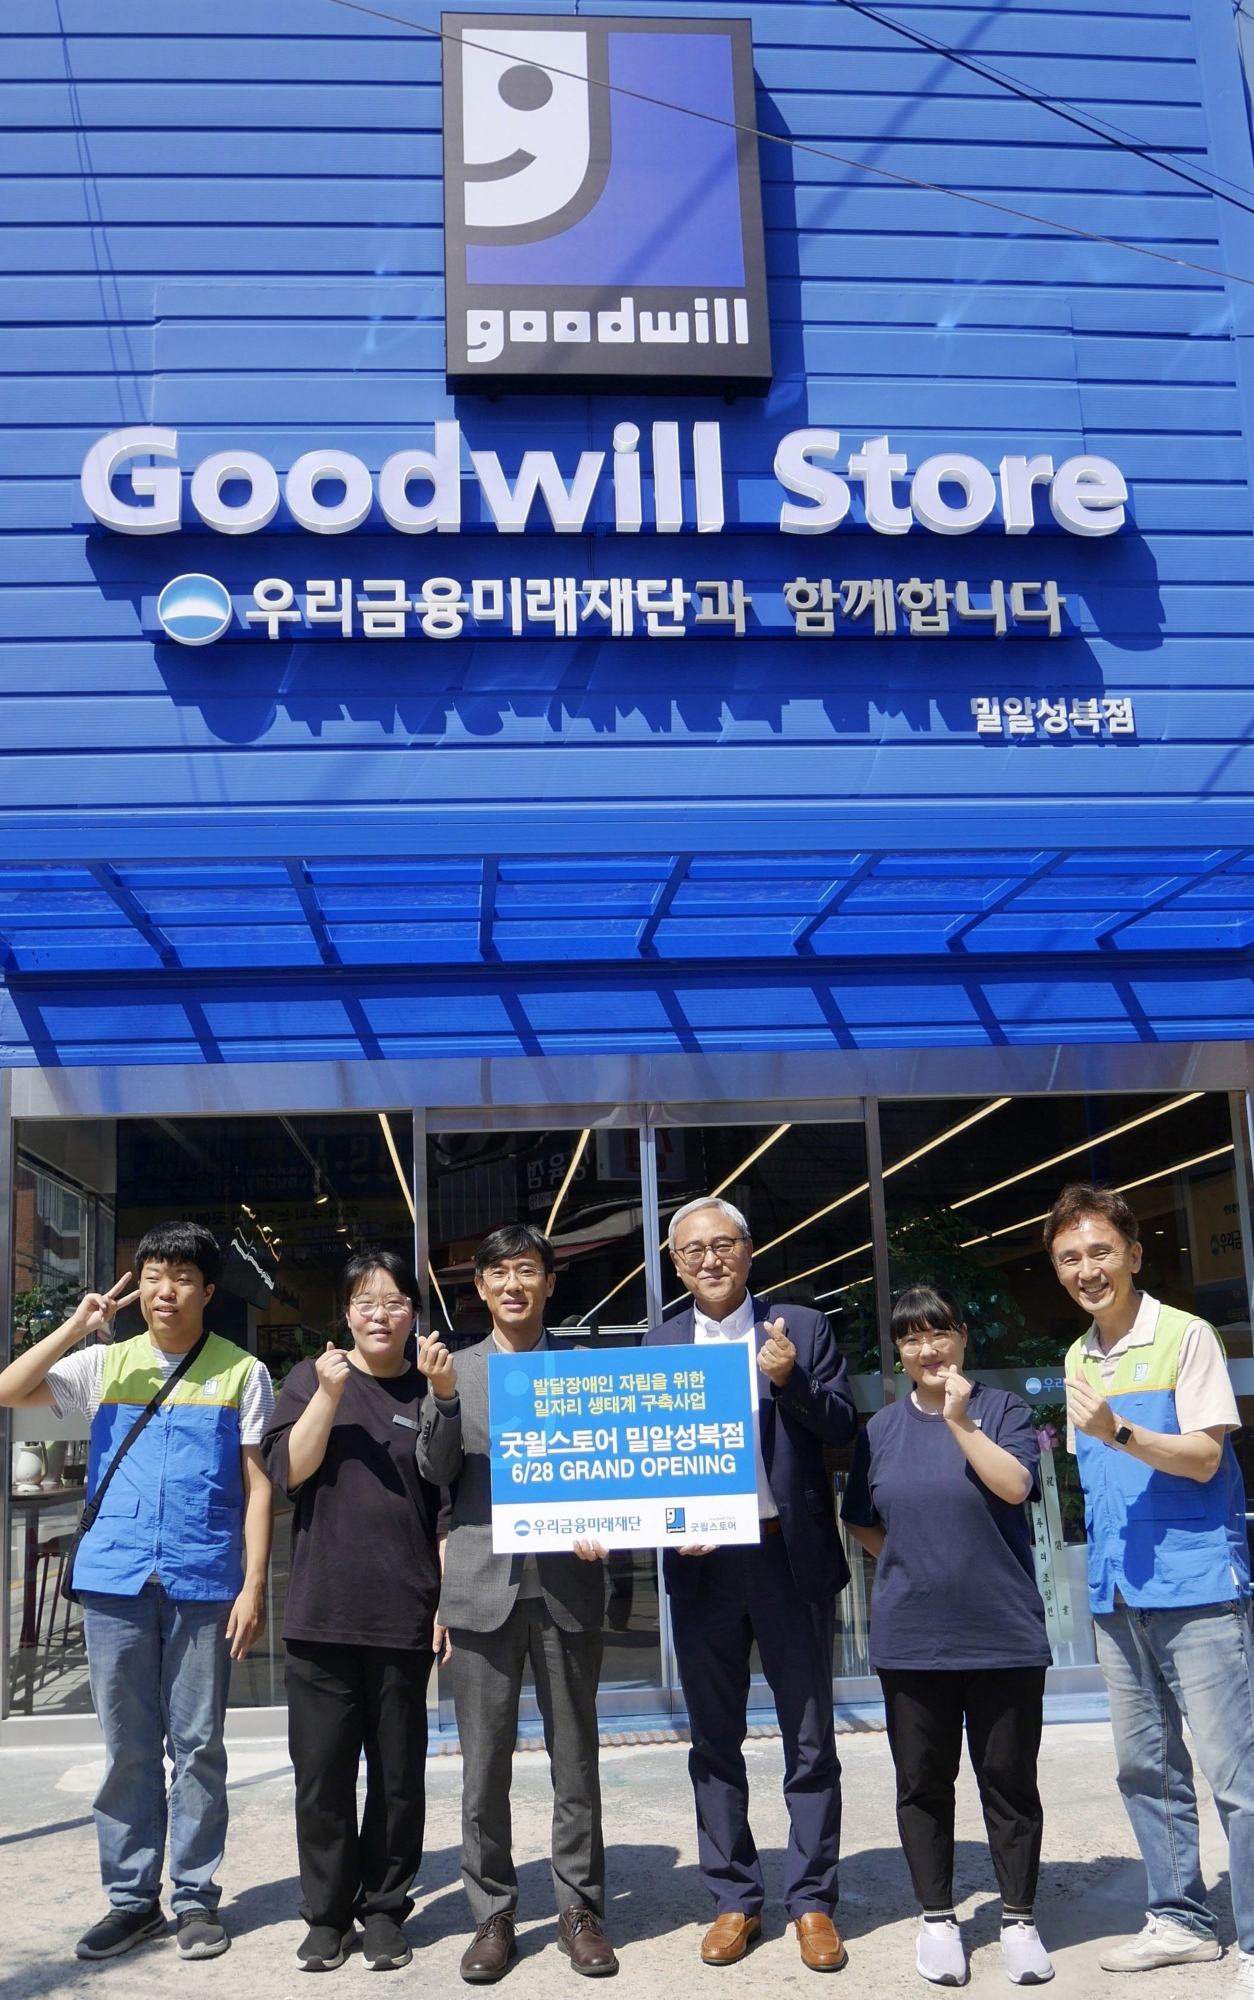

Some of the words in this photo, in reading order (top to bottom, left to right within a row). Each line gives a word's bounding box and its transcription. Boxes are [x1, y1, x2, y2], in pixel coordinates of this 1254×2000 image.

[466, 297, 749, 363] goodwill
[81, 420, 724, 536] Goodwill
[774, 428, 1129, 537] Store
[246, 577, 752, 640] 우리금융미래재단과
[784, 576, 1066, 637] 함께합니다
[971, 697, 1135, 735] 밀알성북점
[533, 1374, 614, 1396] 발달장애인
[619, 1372, 668, 1393] 자립을
[673, 1370, 705, 1389] 위한
[534, 1397, 582, 1417] 일자리
[588, 1395, 636, 1415] 생태계
[640, 1392, 706, 1412] 구축사업
[499, 1427, 618, 1459] 굿윌스토어
[626, 1421, 745, 1453] 밀알성북점
[511, 1461, 554, 1484] 6/28
[559, 1459, 635, 1481] GRAND
[640, 1453, 737, 1478] OPENING
[533, 1516, 642, 1535] 우리금융미래재단
[690, 1521, 737, 1533] 굿윌스토어
